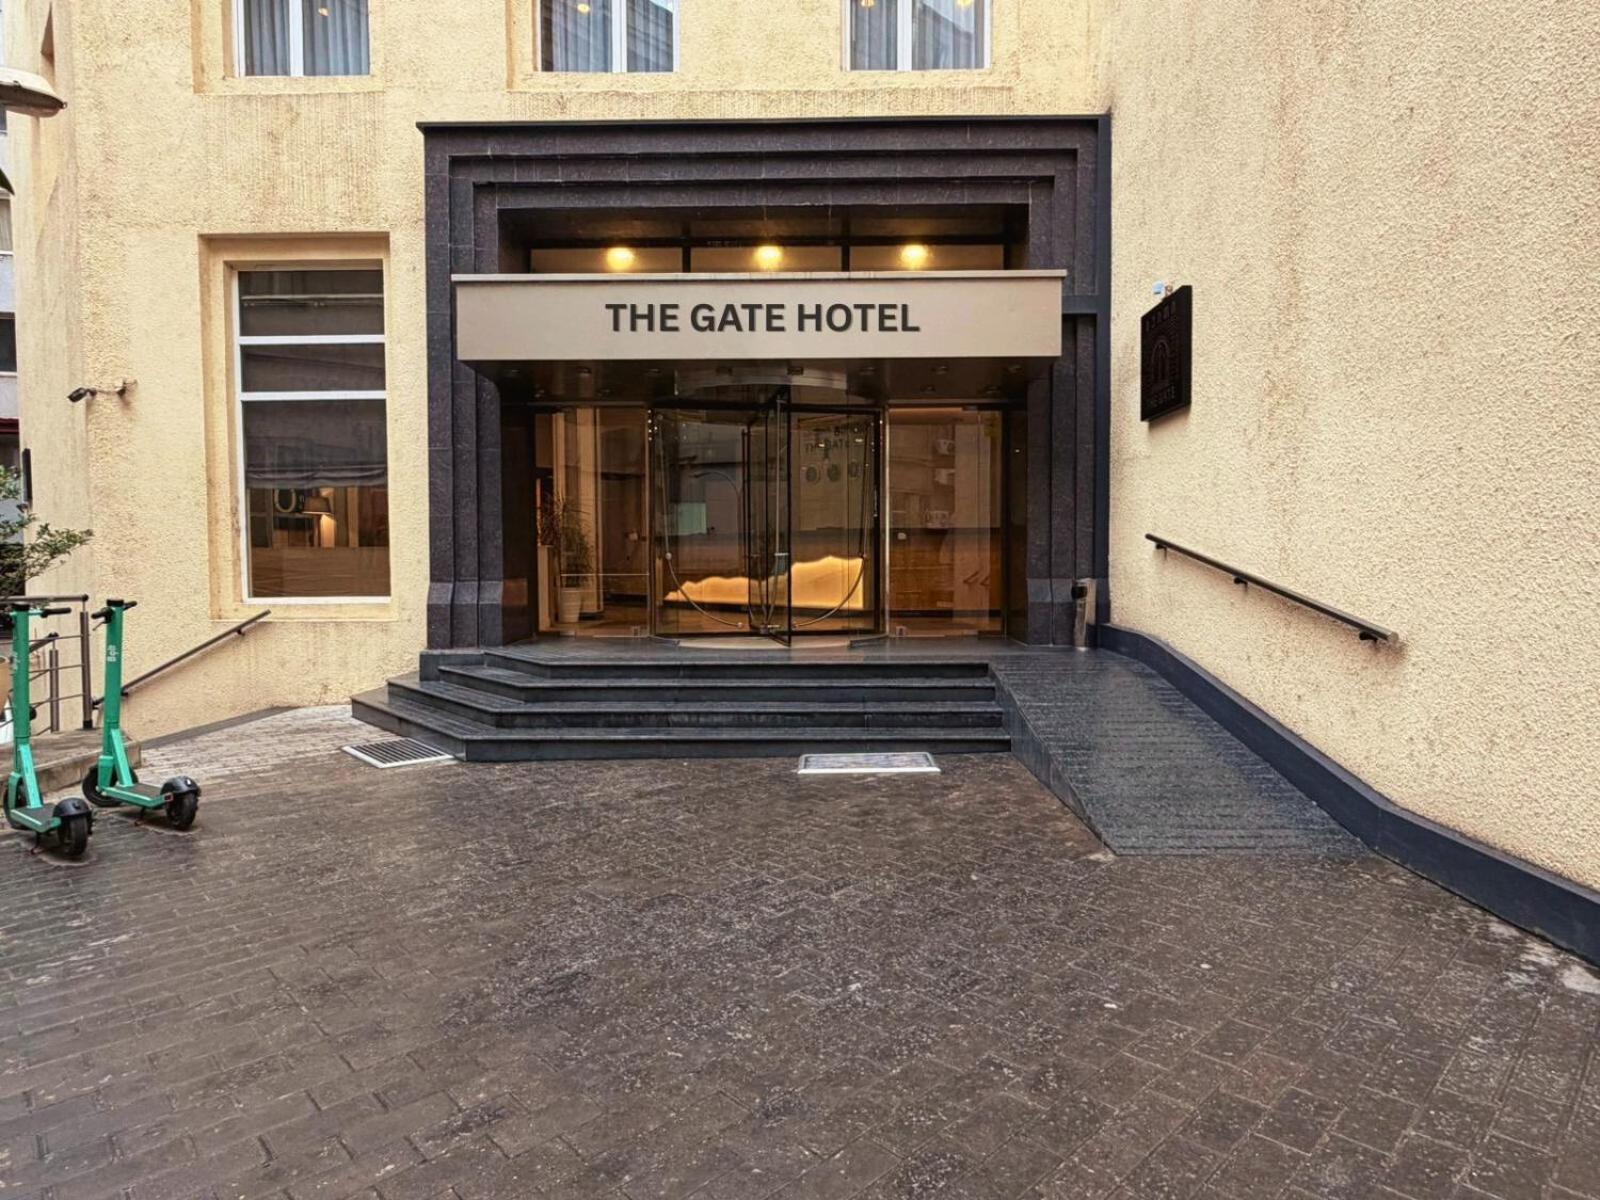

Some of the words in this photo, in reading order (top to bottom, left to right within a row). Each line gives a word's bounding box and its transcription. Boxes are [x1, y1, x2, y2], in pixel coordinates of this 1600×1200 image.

[605, 303, 680, 333] THE
[691, 303, 786, 333] GATE
[798, 303, 921, 333] HOTEL
